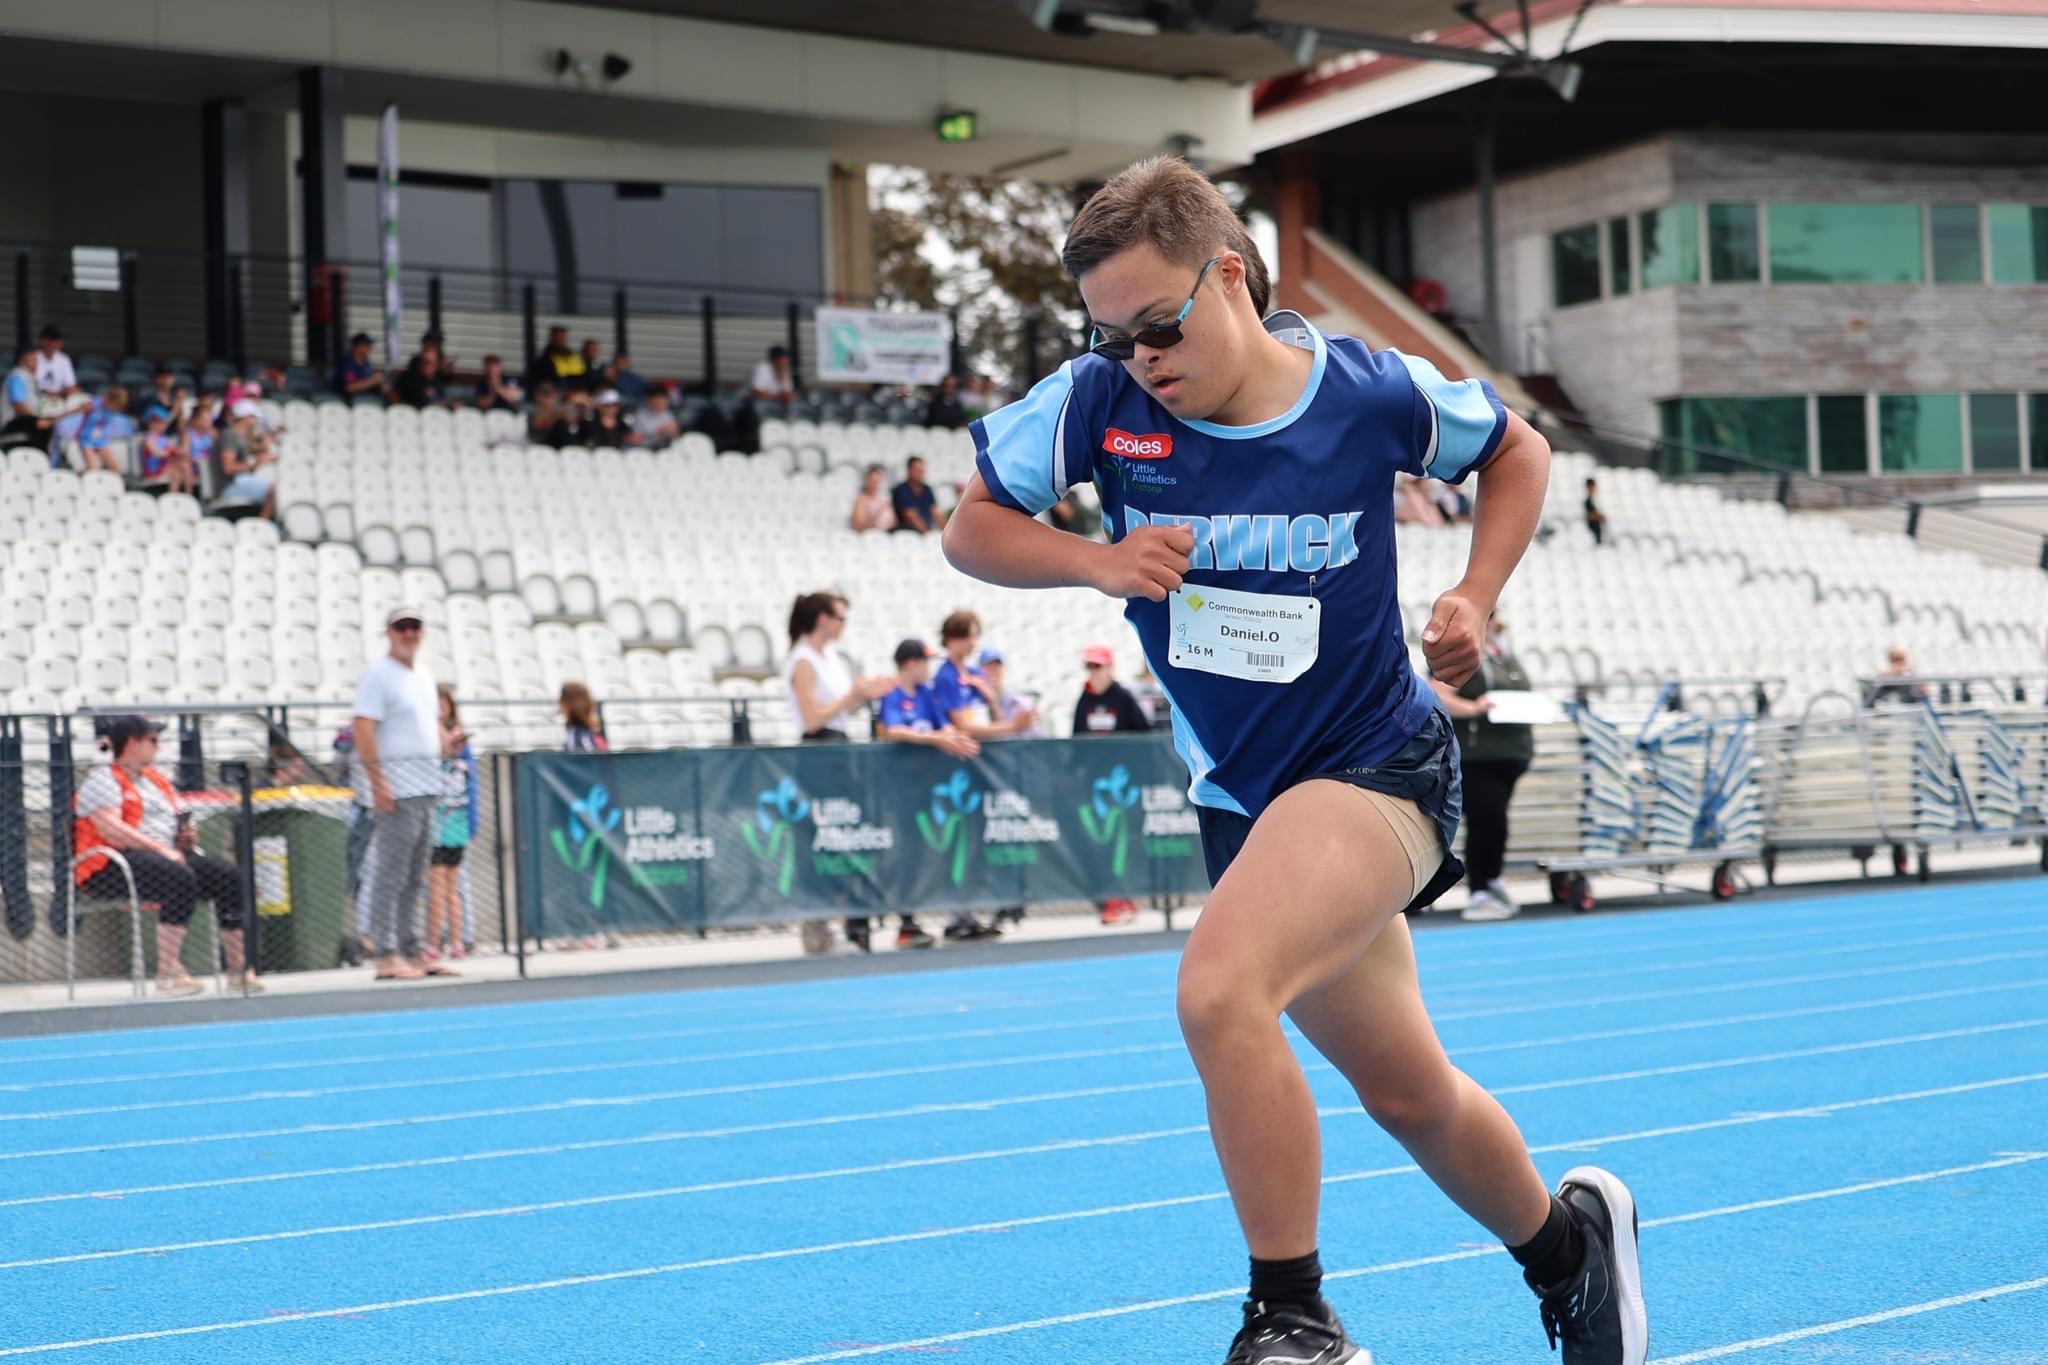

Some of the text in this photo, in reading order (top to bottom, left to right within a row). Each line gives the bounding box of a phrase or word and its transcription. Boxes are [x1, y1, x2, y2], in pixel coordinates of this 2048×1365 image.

[1132, 463, 1156, 474] Little
[1132, 473, 1177, 485] Athletics
[1124, 504, 1364, 573] RWICK
[1208, 601, 1278, 619] Commonwealth
[1279, 610, 1303, 621] Bank
[1220, 625, 1280, 643] Daniel.O
[1187, 644, 1214, 657] 16 M
